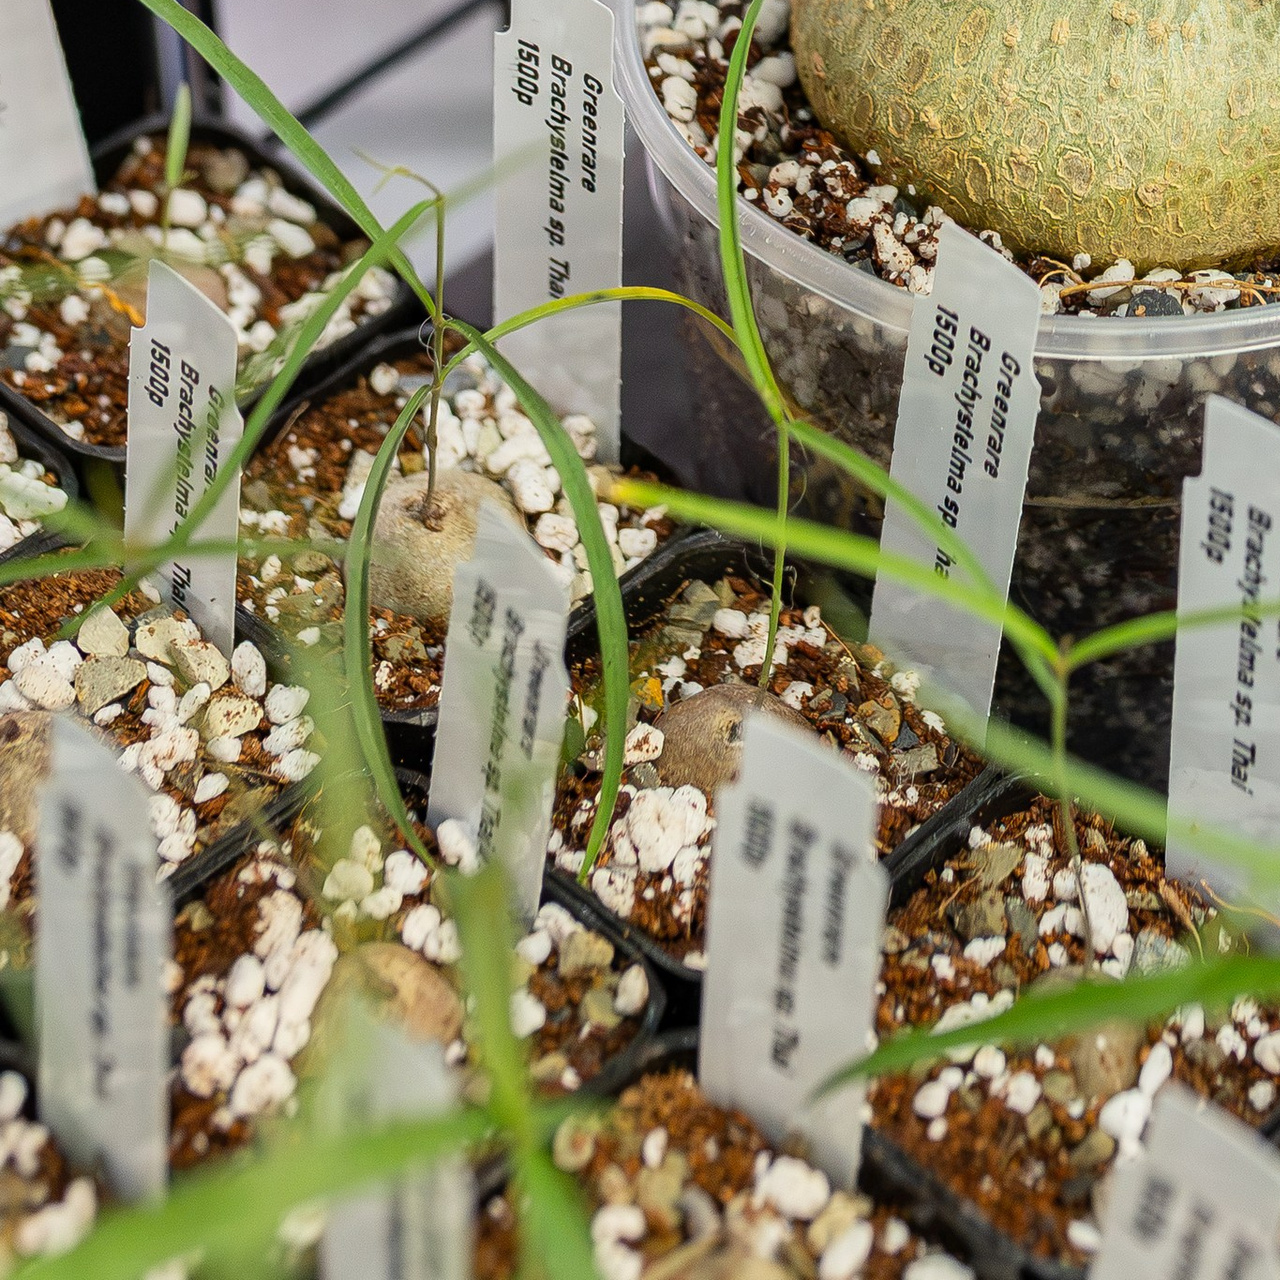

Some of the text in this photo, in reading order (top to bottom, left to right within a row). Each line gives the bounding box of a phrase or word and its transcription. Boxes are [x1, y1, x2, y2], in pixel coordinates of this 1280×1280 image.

[511, 38, 540, 107] 1500p
[544, 53, 573, 214] Brachystelma
[581, 71, 604, 193] Greenrare
[542, 216, 566, 247] sp.
[143, 337, 172, 408] 1500p
[923, 303, 960, 377] 1500p
[172, 358, 201, 523] Brachystelma
[946, 324, 992, 494] Brachystelma
[983, 350, 1021, 479] Greenrare
[1230, 737, 1257, 797] Thai
